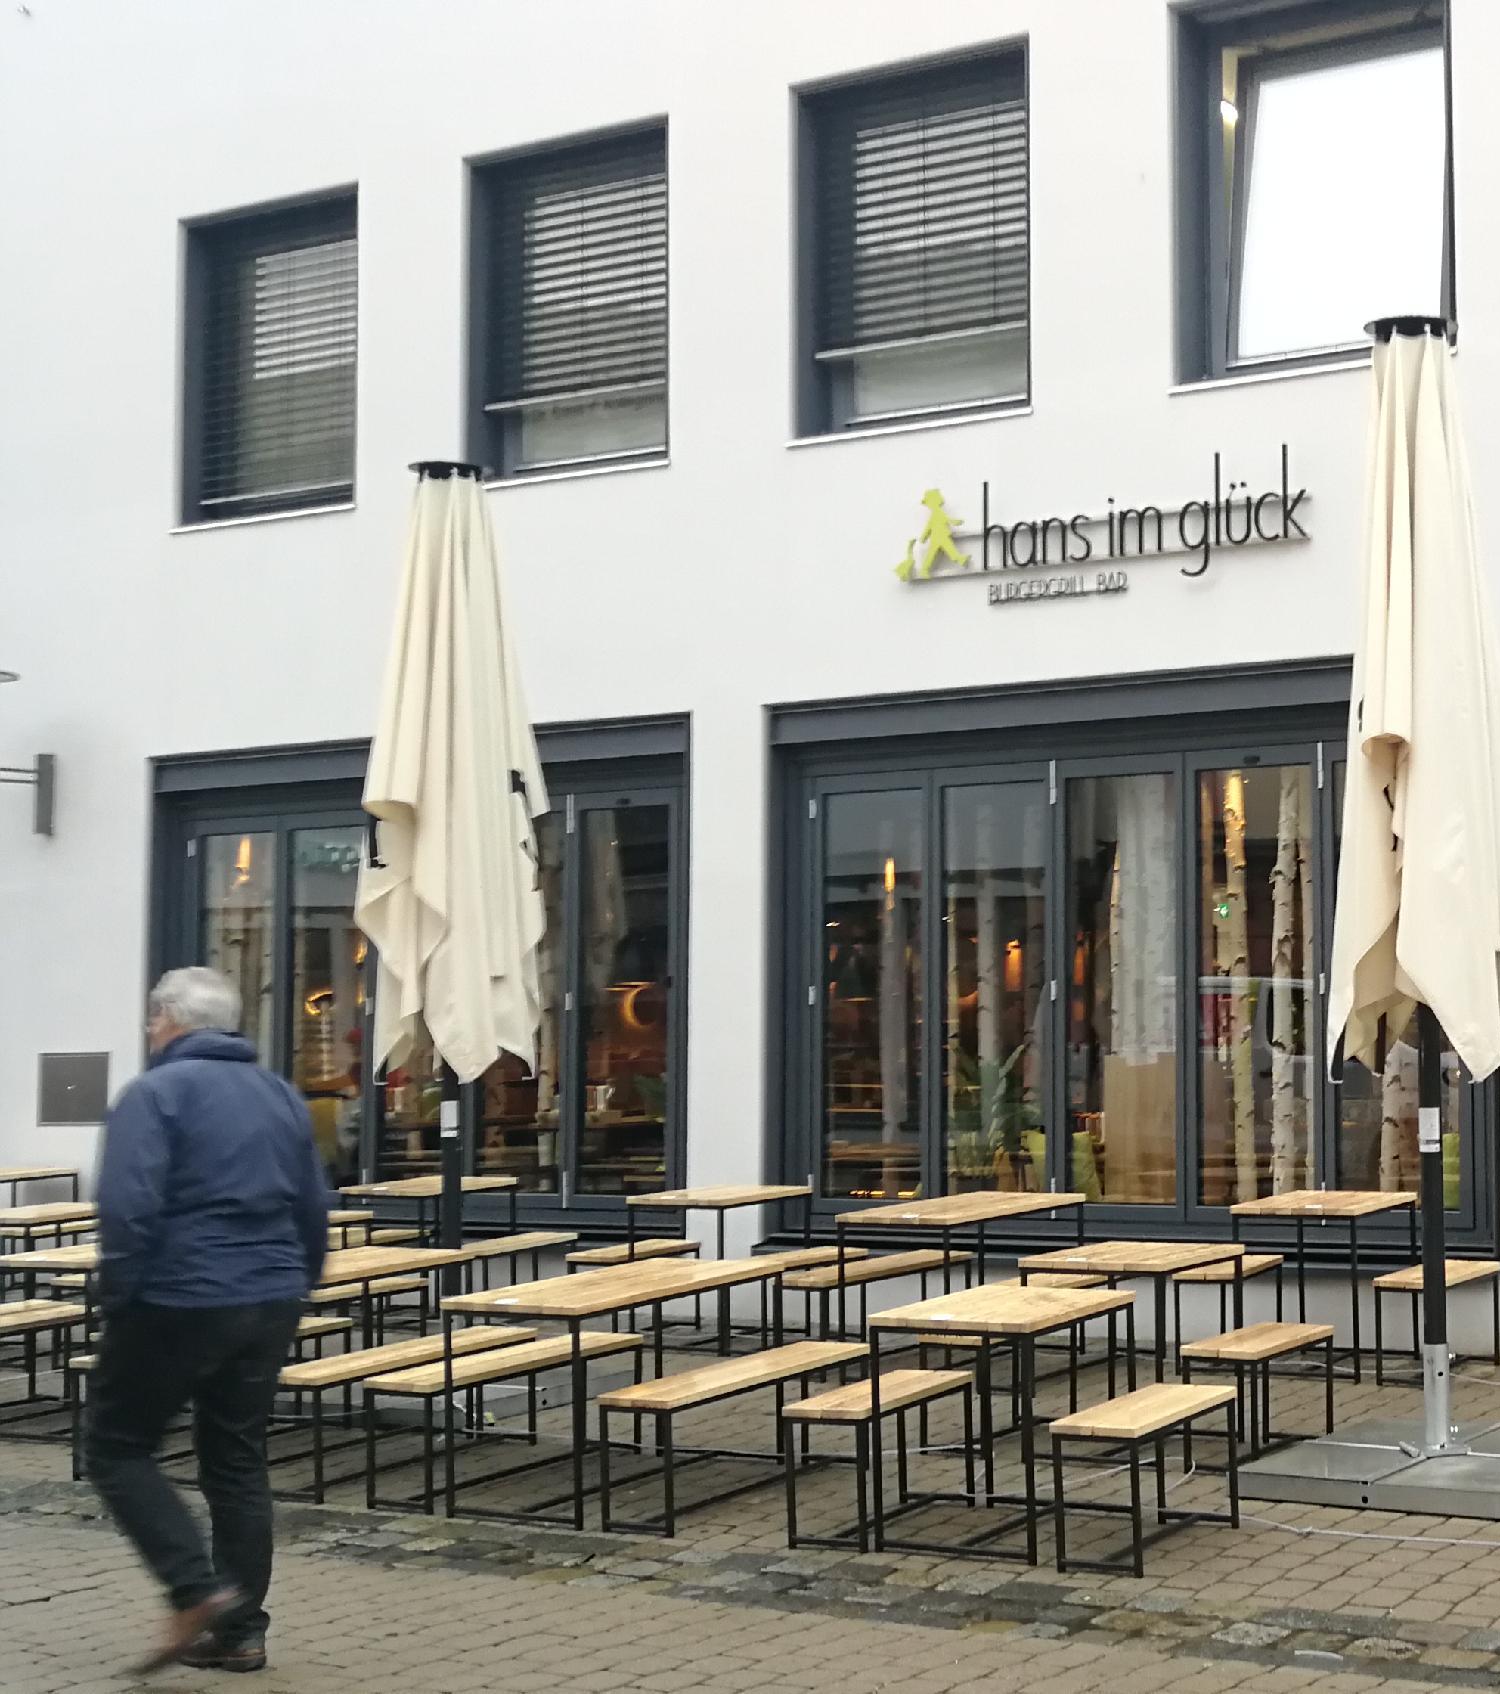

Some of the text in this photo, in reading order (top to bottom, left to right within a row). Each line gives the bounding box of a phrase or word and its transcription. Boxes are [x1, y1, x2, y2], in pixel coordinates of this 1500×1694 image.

[982, 443, 1309, 577] hans im glück
